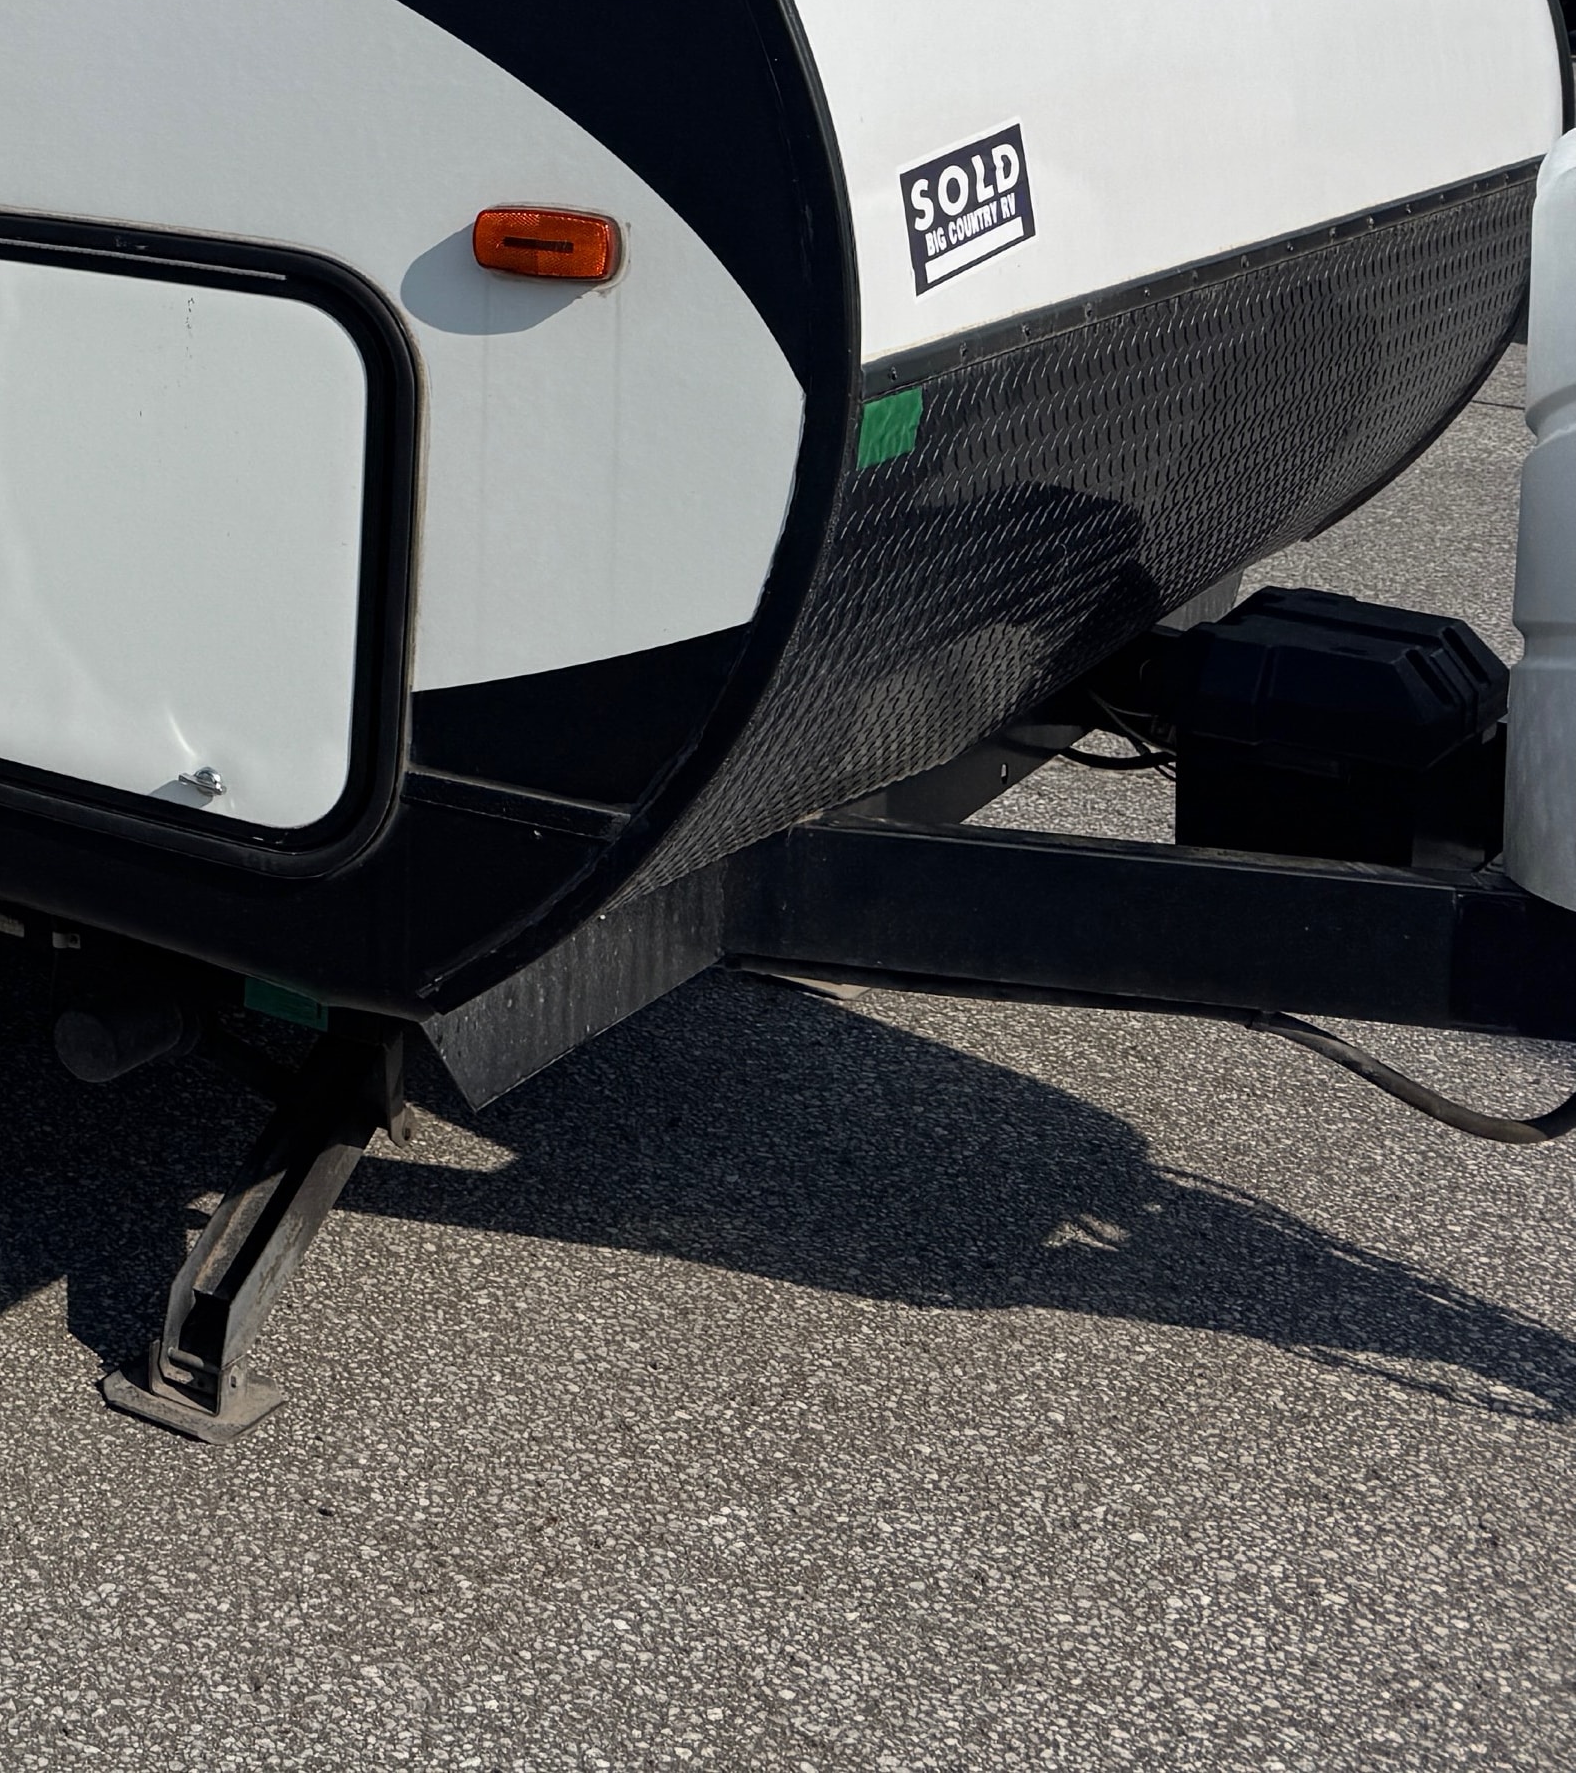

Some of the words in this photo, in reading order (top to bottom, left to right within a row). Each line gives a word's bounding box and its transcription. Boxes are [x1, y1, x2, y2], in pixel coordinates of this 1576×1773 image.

[911, 143, 1020, 231] SOLD
[925, 226, 947, 257] BIG
[948, 200, 998, 245] COUNTRY
[1000, 192, 1016, 219] RV
